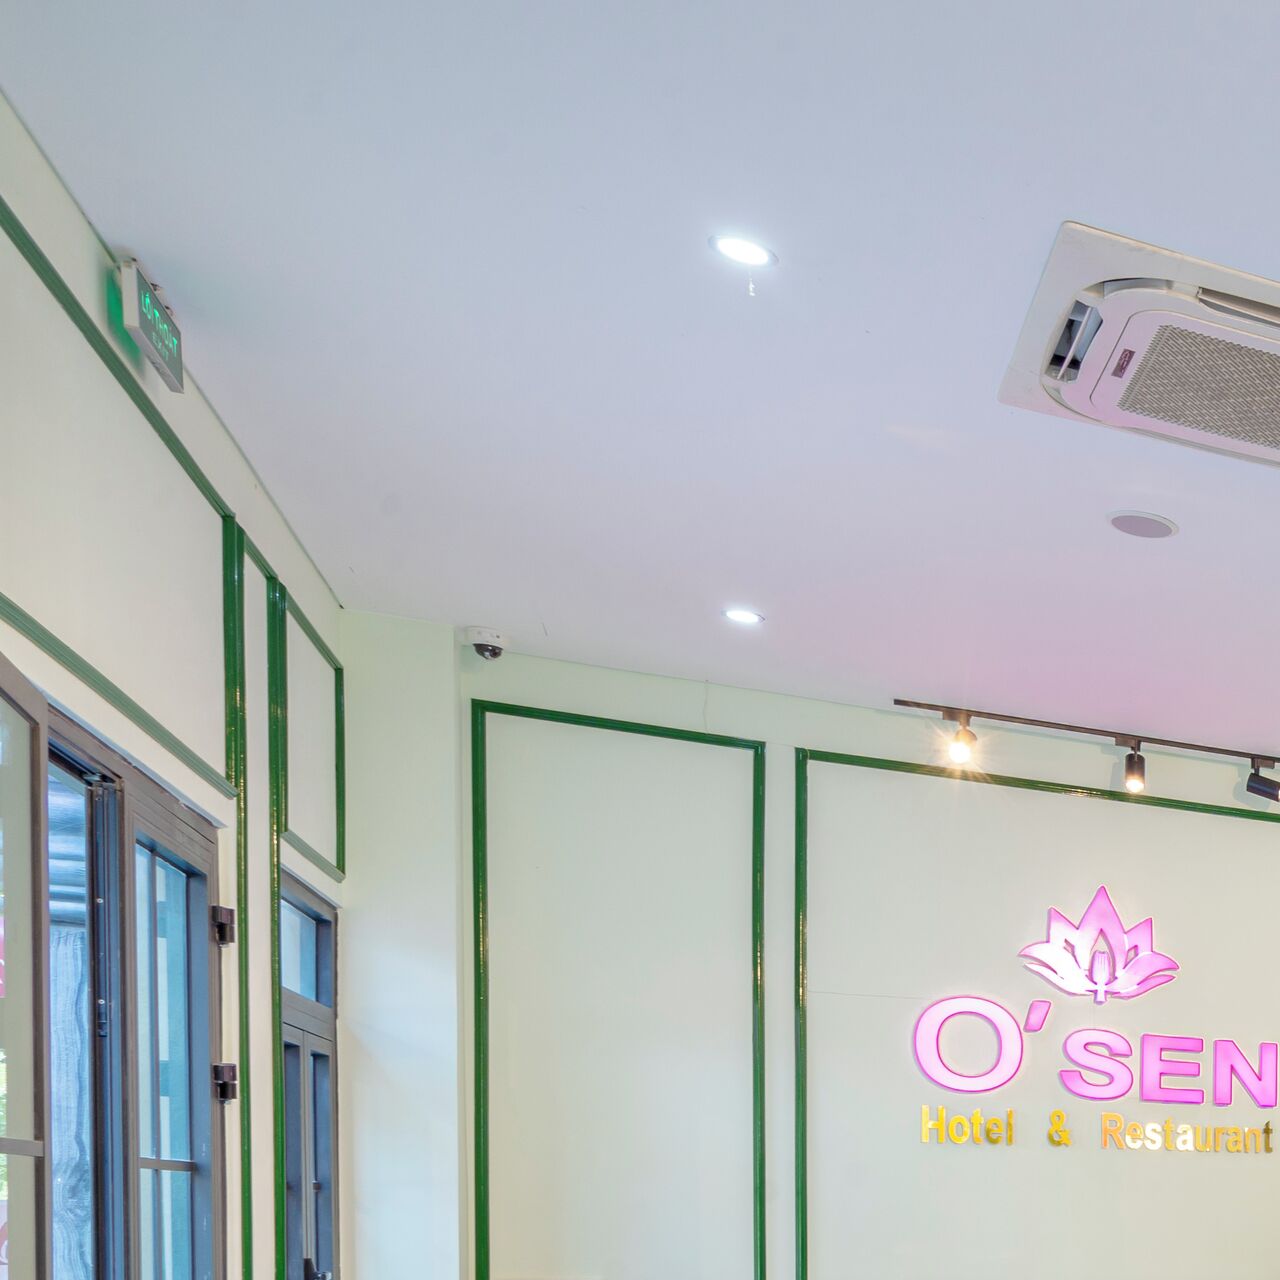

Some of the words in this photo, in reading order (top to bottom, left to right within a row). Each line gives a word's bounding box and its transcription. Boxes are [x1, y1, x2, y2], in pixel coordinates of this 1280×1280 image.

[913, 995, 1279, 1108] O'SEN
[920, 1105, 1014, 1146] Hotel
[1048, 1109, 1072, 1147] &
[1100, 1112, 1274, 1153] Restaurant
